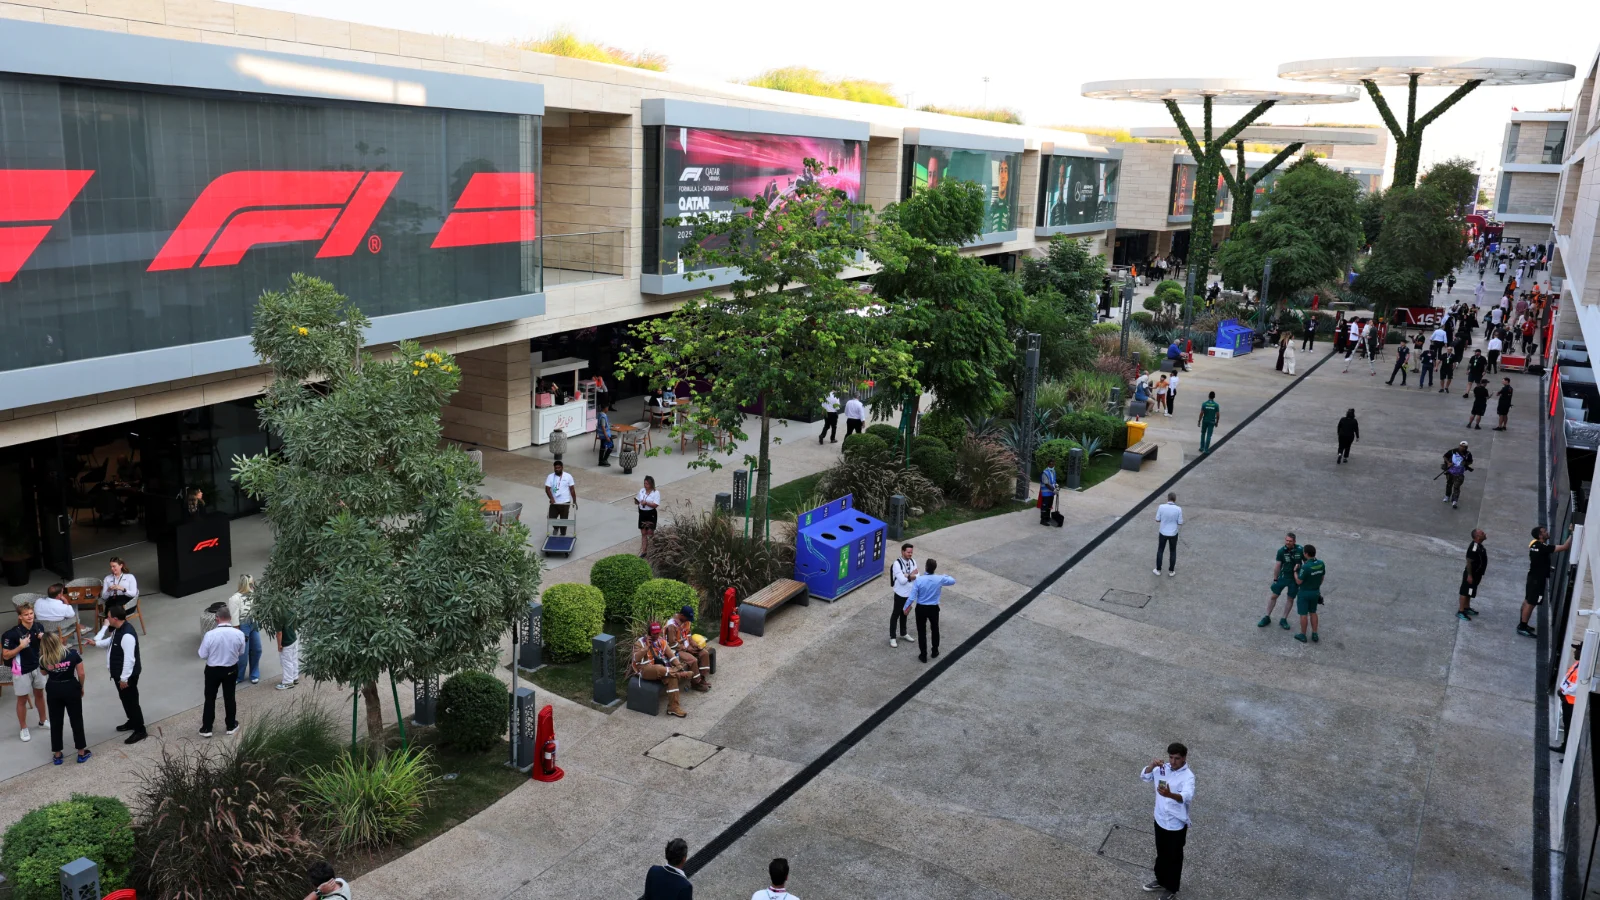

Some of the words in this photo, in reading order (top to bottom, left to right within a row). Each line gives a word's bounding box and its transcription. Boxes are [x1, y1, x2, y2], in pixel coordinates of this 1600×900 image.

[705, 168, 720, 176] QATAR
[679, 197, 710, 210] QATAR
[678, 230, 692, 239] 2025
